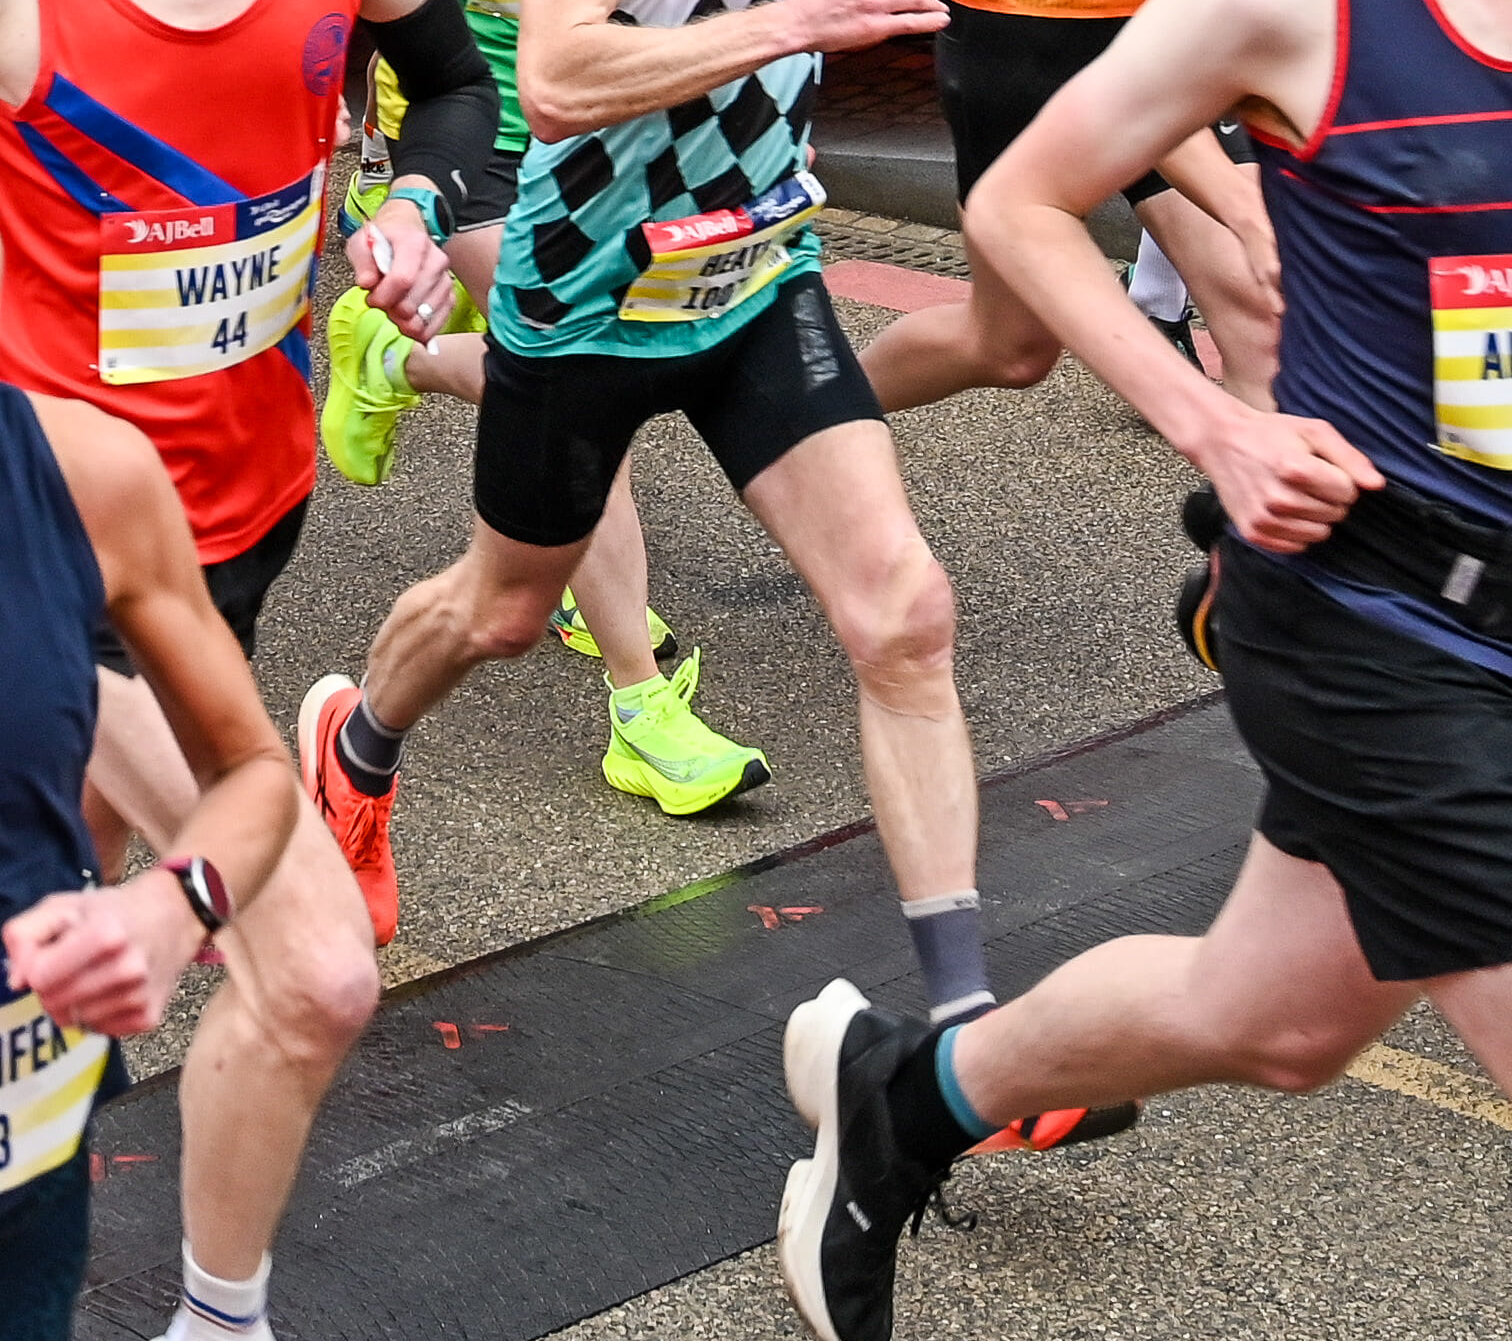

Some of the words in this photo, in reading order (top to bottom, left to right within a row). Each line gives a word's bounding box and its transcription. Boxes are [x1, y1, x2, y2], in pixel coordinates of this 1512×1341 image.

[147, 216, 214, 243] AJBell
[177, 245, 281, 307] WAYNE
[210, 311, 249, 354] 44
